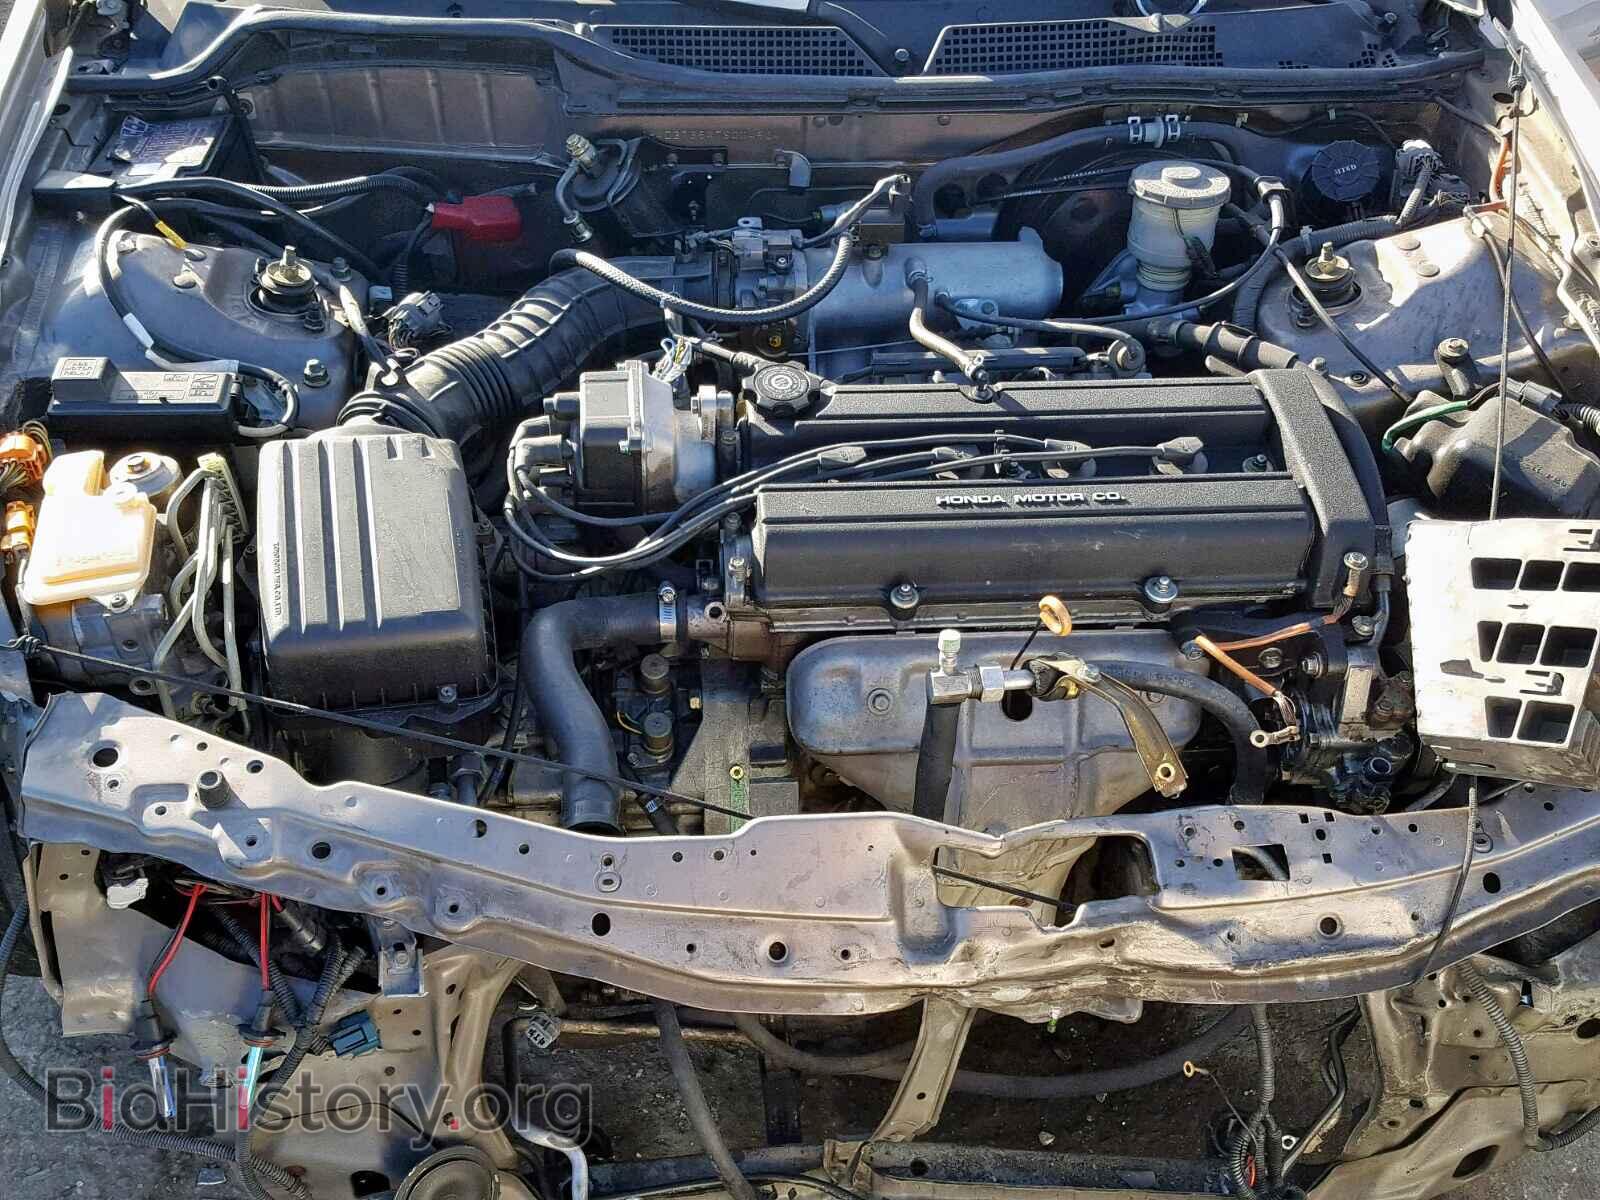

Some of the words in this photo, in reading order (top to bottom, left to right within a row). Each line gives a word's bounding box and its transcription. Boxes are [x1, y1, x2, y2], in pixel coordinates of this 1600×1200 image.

[935, 494, 1006, 505] HONDA
[1013, 492, 1085, 503] MOTOR
[1092, 491, 1127, 501] CO.
